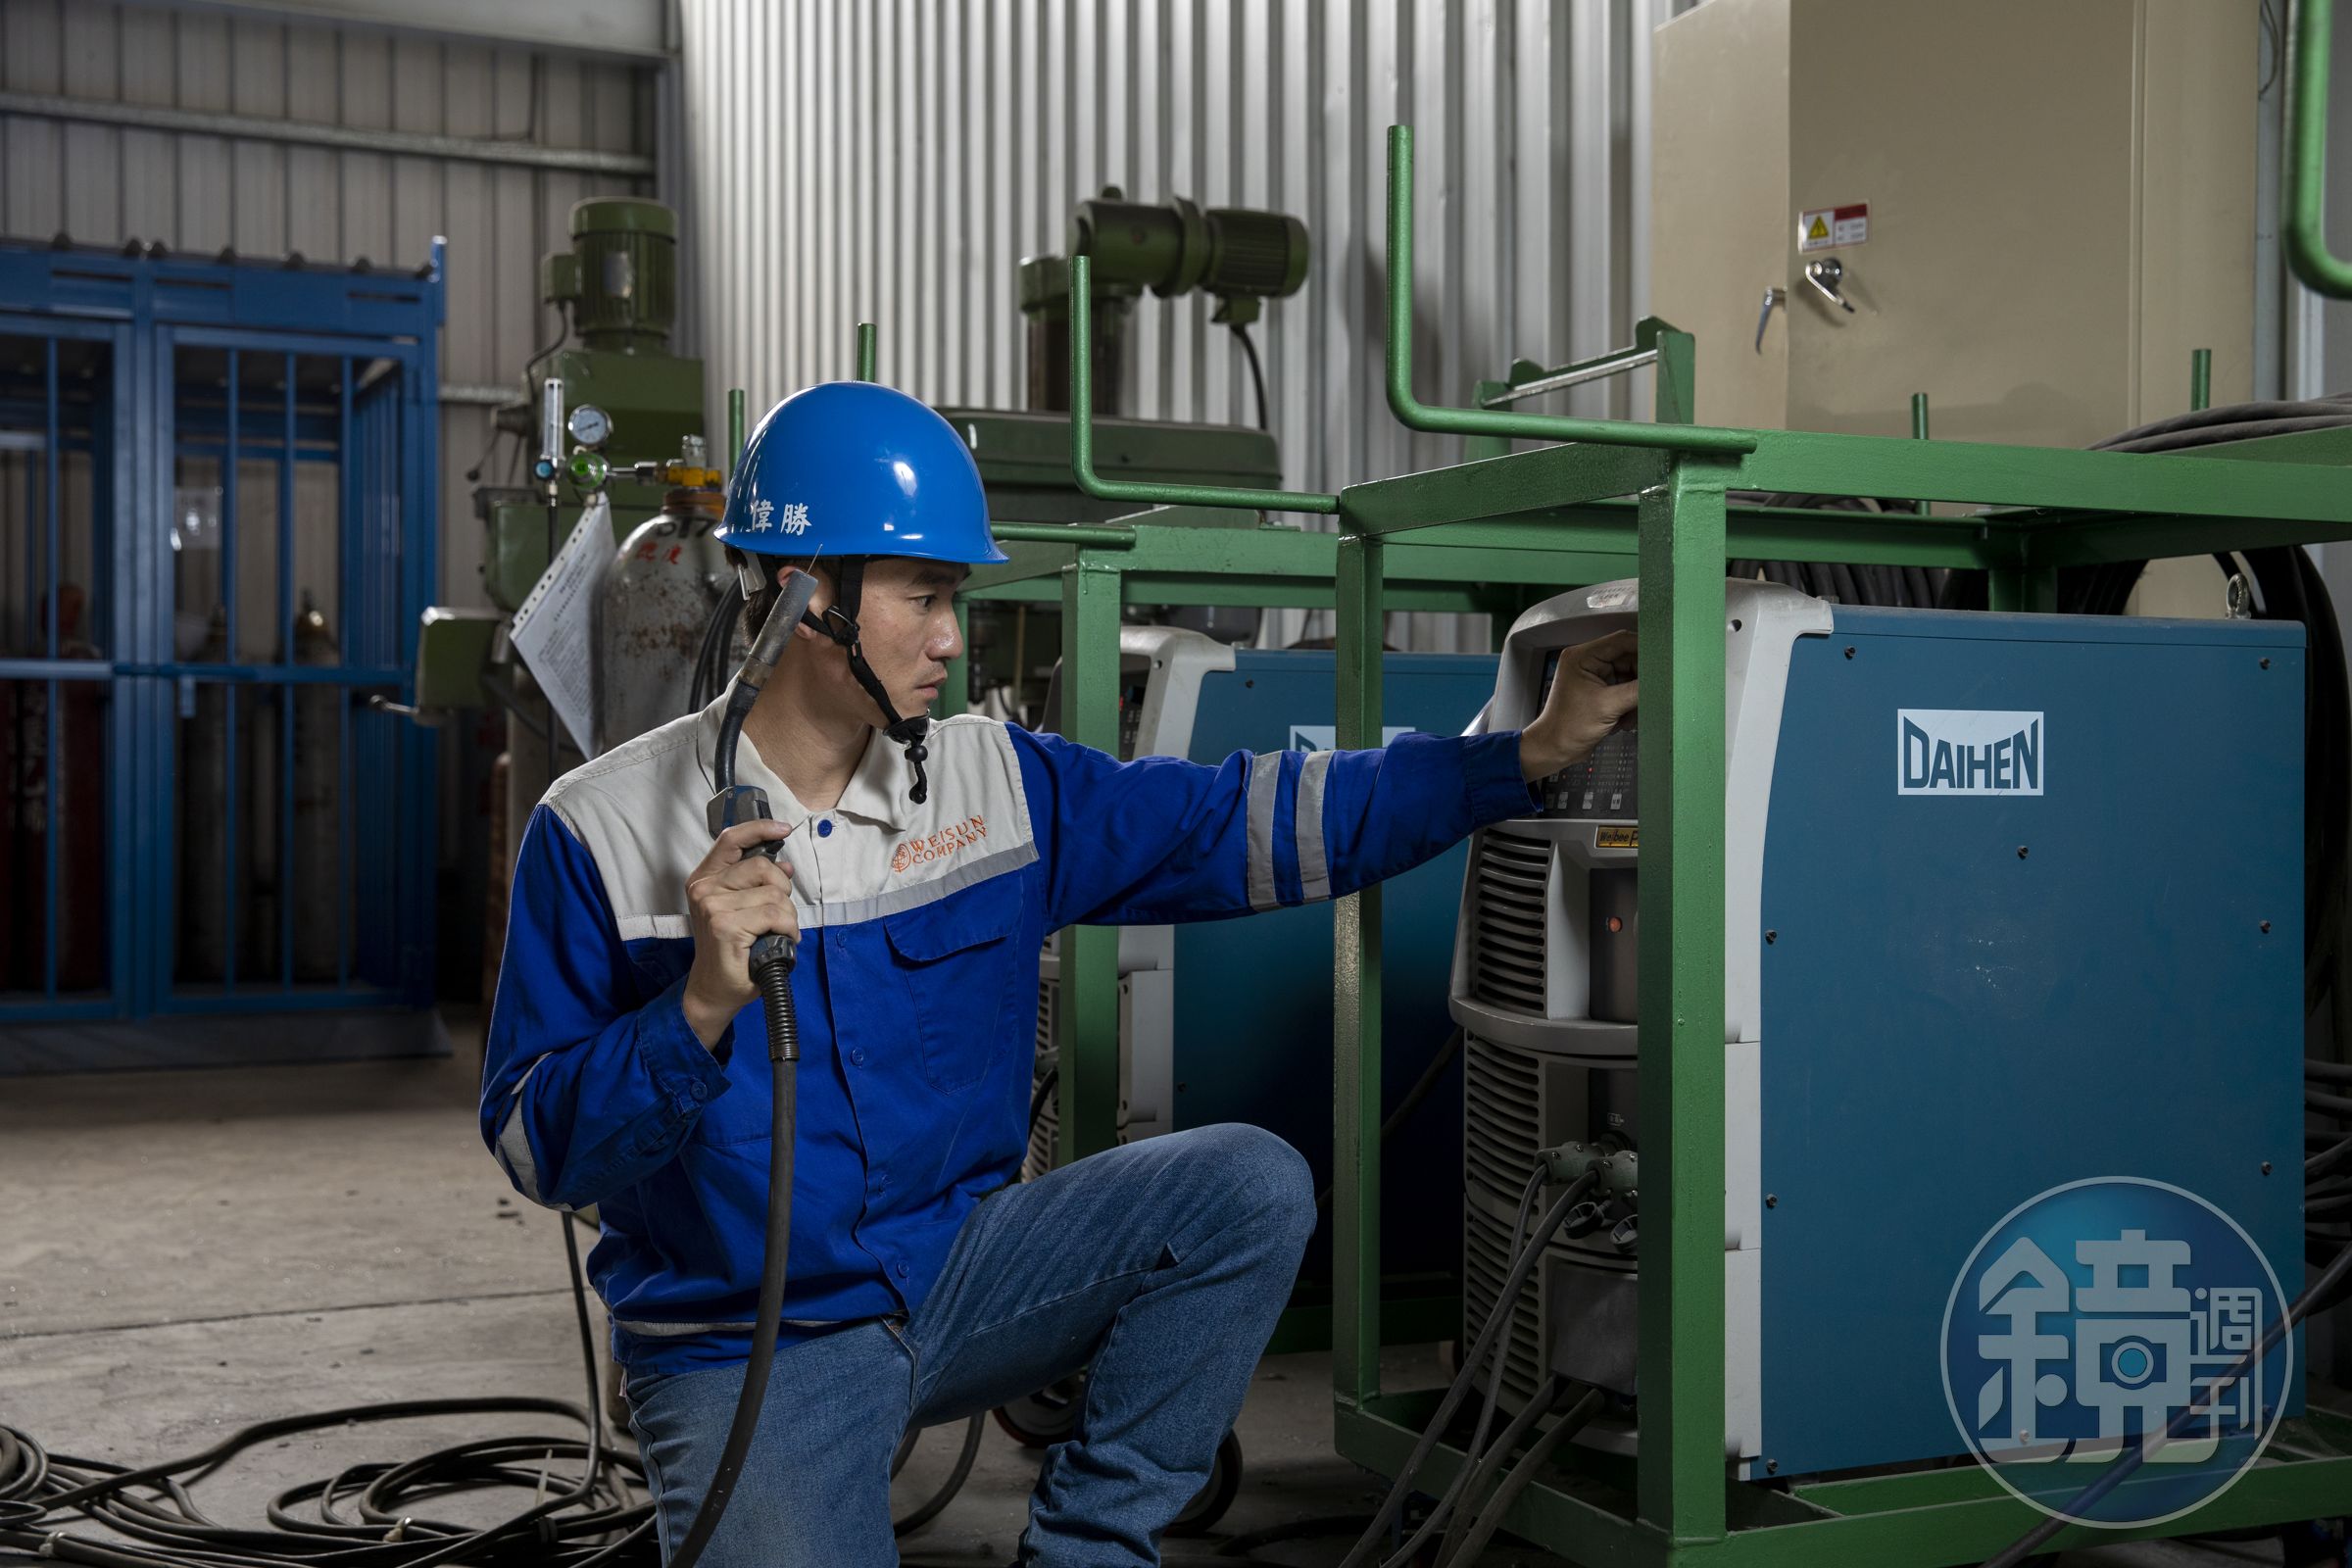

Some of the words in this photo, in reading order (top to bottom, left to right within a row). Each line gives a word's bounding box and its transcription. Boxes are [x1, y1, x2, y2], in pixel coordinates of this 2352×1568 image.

[751, 499, 812, 536] 偉勝
[1903, 715, 2038, 789] DAIHEN
[909, 814, 985, 853] WEISUN
[912, 826, 988, 863] COMPANY
